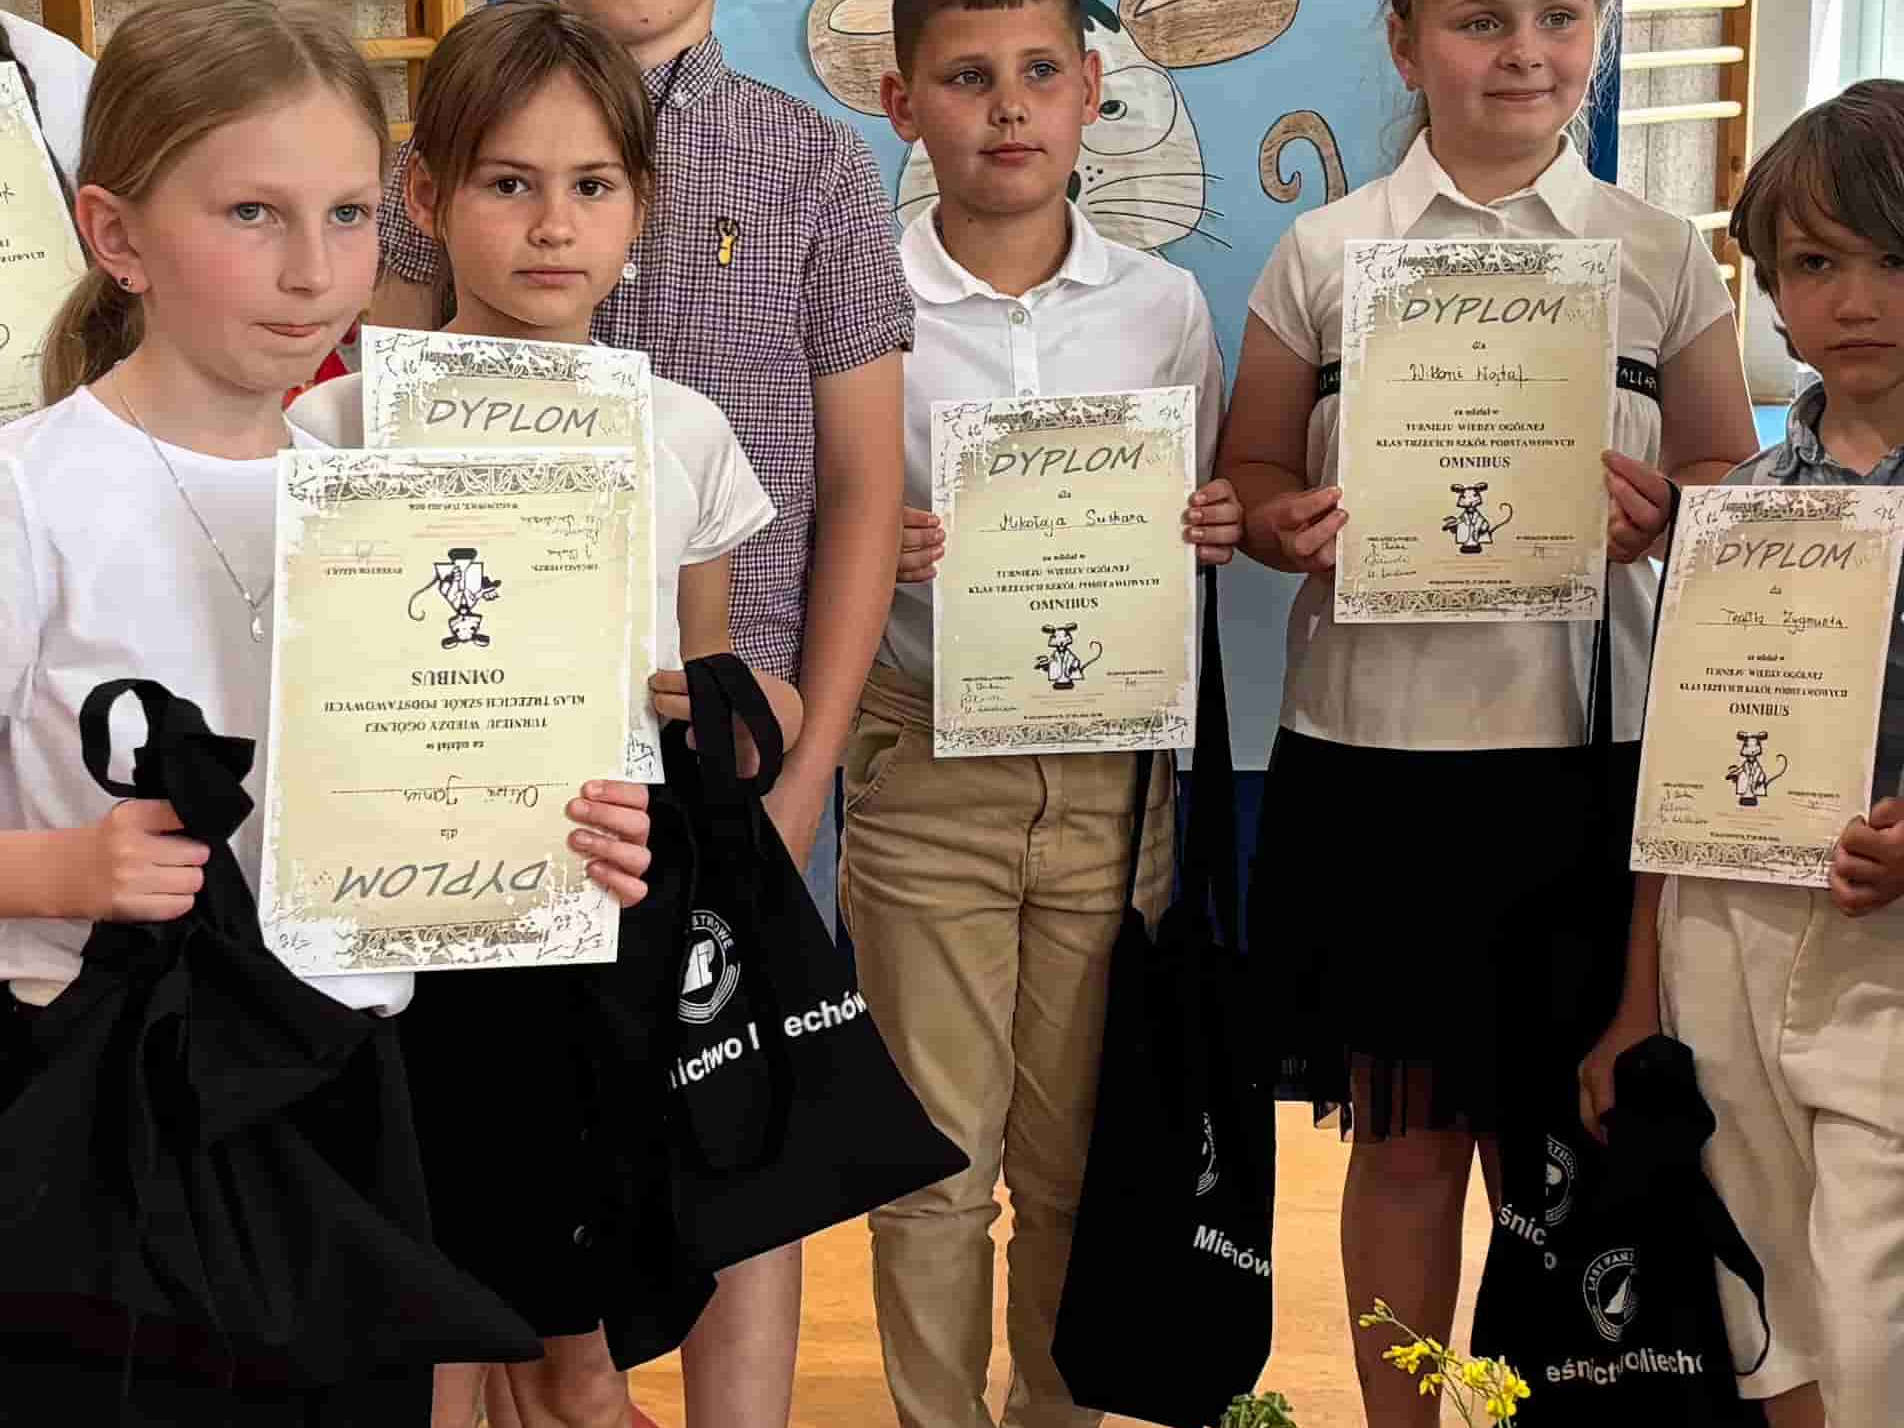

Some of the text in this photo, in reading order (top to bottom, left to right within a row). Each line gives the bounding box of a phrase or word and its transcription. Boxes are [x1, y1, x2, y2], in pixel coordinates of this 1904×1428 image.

[1401, 293, 1566, 324] DYPLOM
[425, 397, 599, 437] DYPLOM
[989, 442, 1145, 476] DYPLOM
[1440, 456, 1511, 468] OMNIBUS
[1716, 540, 1857, 570] DYPLOM
[1030, 598, 1099, 611] OMNIBUS
[412, 668, 504, 686] OMNIBUS
[324, 700, 437, 712] PODSTAWOWYCH
[487, 696, 549, 708] TRZECICH
[553, 695, 585, 705] KLAS
[1729, 703, 1789, 716] OMNIBUS
[365, 722, 426, 734] OGÓLNEJ
[430, 720, 480, 731] WIEDZY
[441, 829, 458, 840] dla
[332, 860, 548, 903] DYPLOM
